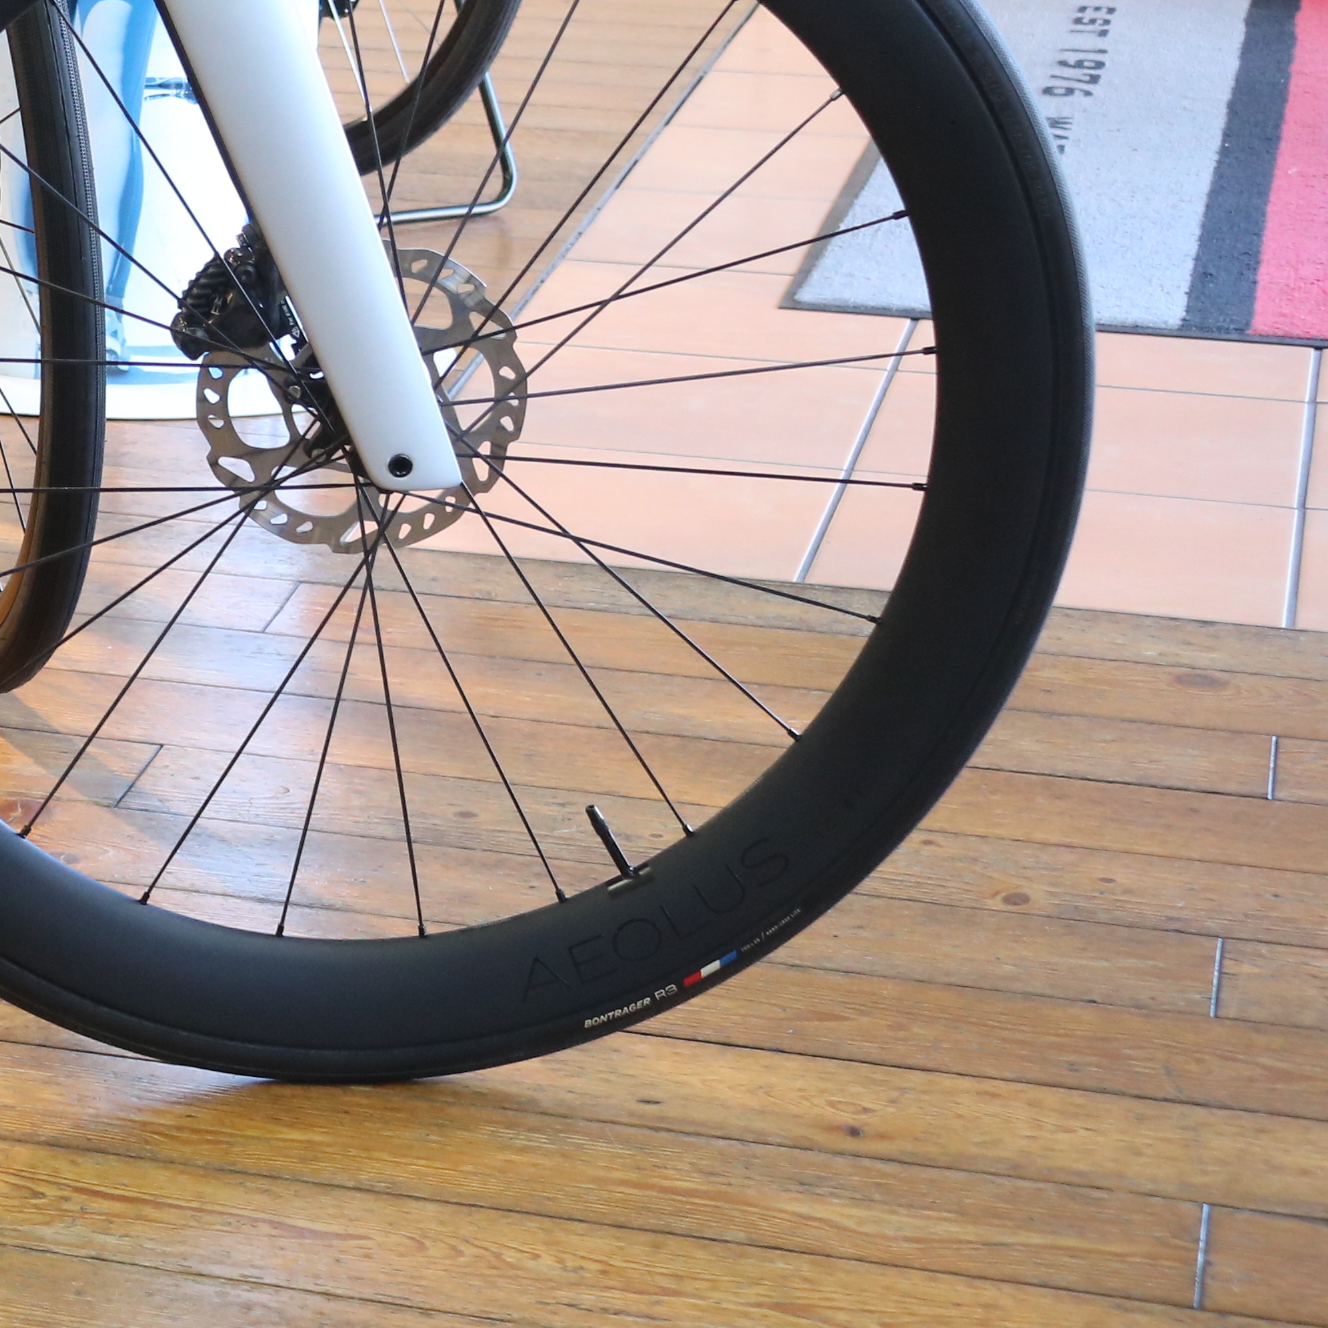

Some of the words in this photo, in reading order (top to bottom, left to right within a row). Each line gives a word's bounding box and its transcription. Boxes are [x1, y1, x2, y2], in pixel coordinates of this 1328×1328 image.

[1068, 5, 1117, 38] EST
[1041, 49, 1108, 97] 1976
[521, 835, 790, 1003] AEOLUS
[583, 996, 652, 1029] BONTRAGER
[654, 983, 678, 1001] R3
